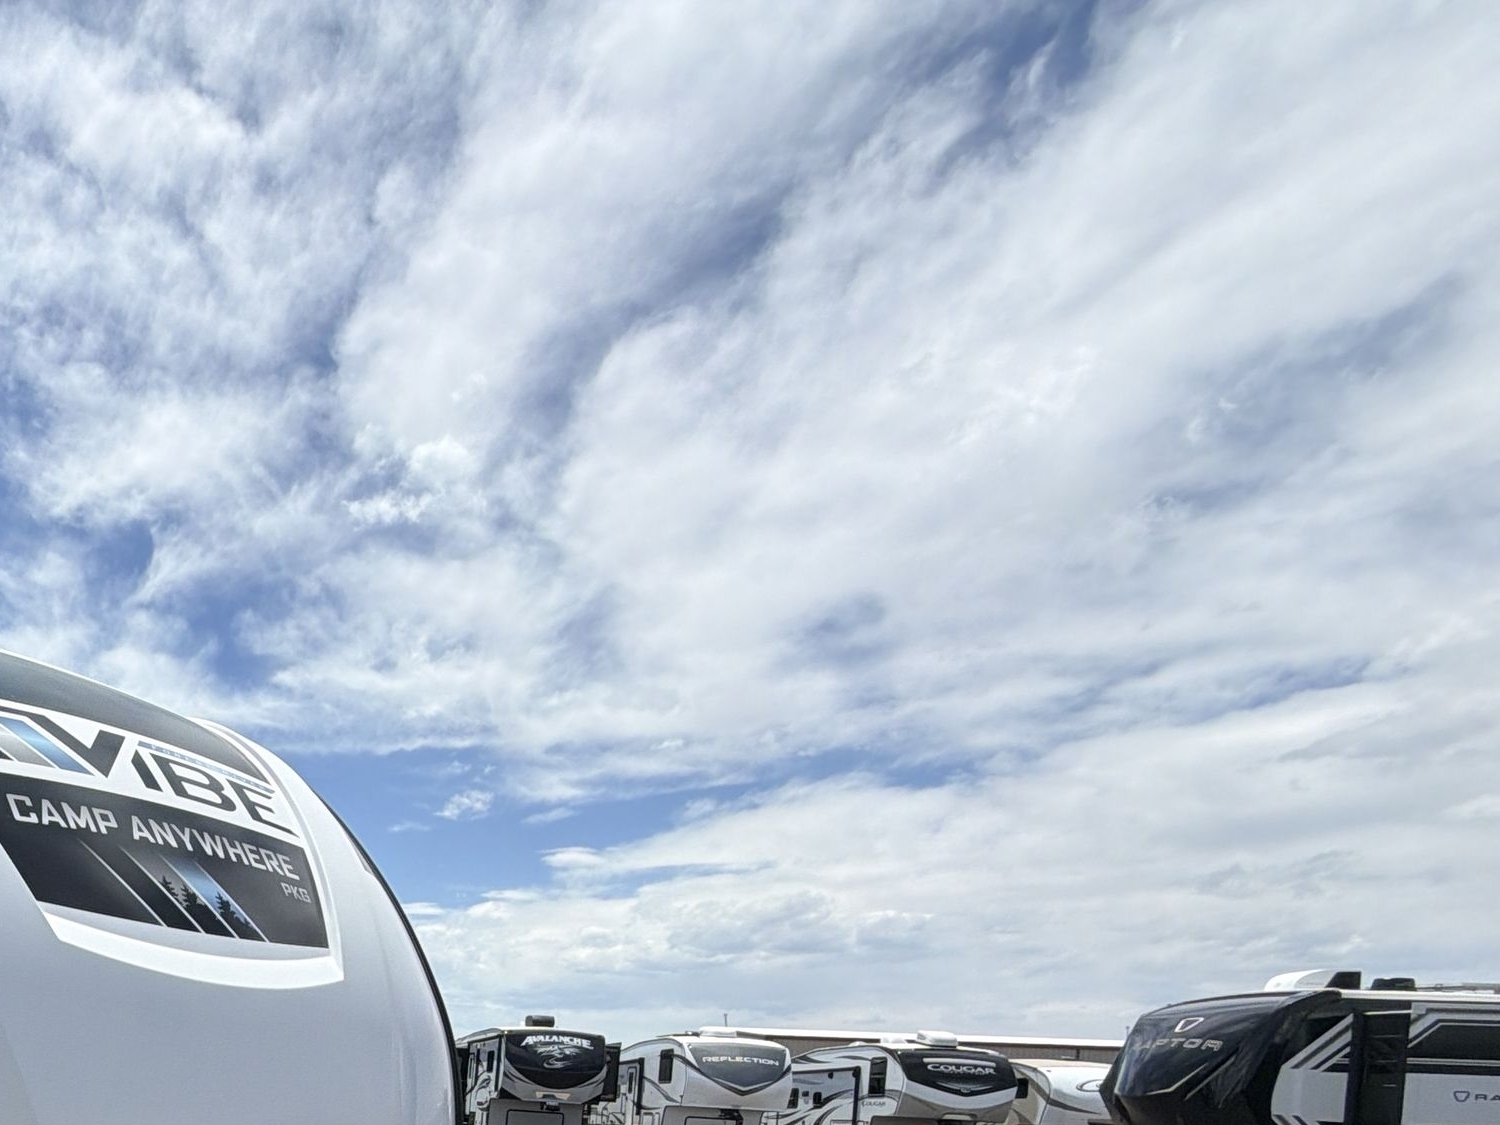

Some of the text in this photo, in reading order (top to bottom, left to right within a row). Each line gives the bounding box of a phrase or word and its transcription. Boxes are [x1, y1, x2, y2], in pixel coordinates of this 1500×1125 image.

[27, 714, 299, 838] VIBE
[5, 793, 300, 880] CAMP ANYWHERE
[281, 882, 312, 904] PKG
[520, 1034, 595, 1050] AVALANCHE
[702, 1056, 780, 1066] REFLECTION
[927, 1063, 996, 1075] COUGAR
